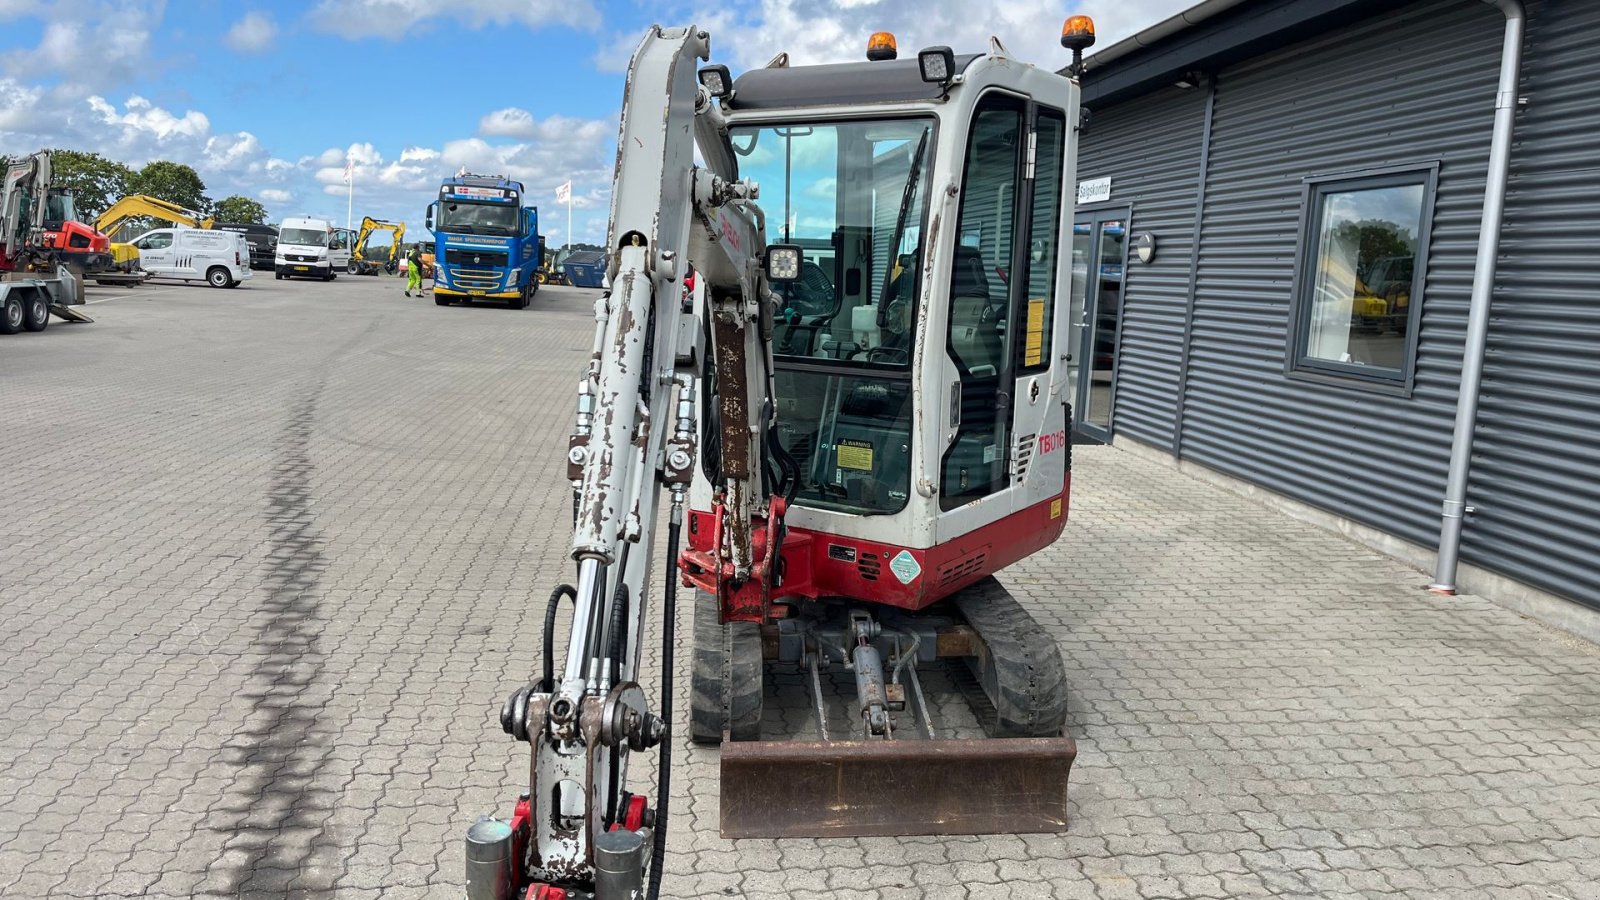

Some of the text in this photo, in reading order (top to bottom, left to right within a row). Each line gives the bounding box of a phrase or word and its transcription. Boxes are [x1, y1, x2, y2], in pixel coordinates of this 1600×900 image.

[1079, 183, 1109, 200] Salgskontor
[848, 440, 870, 448] WARNING
[1039, 430, 1065, 455] TB016
